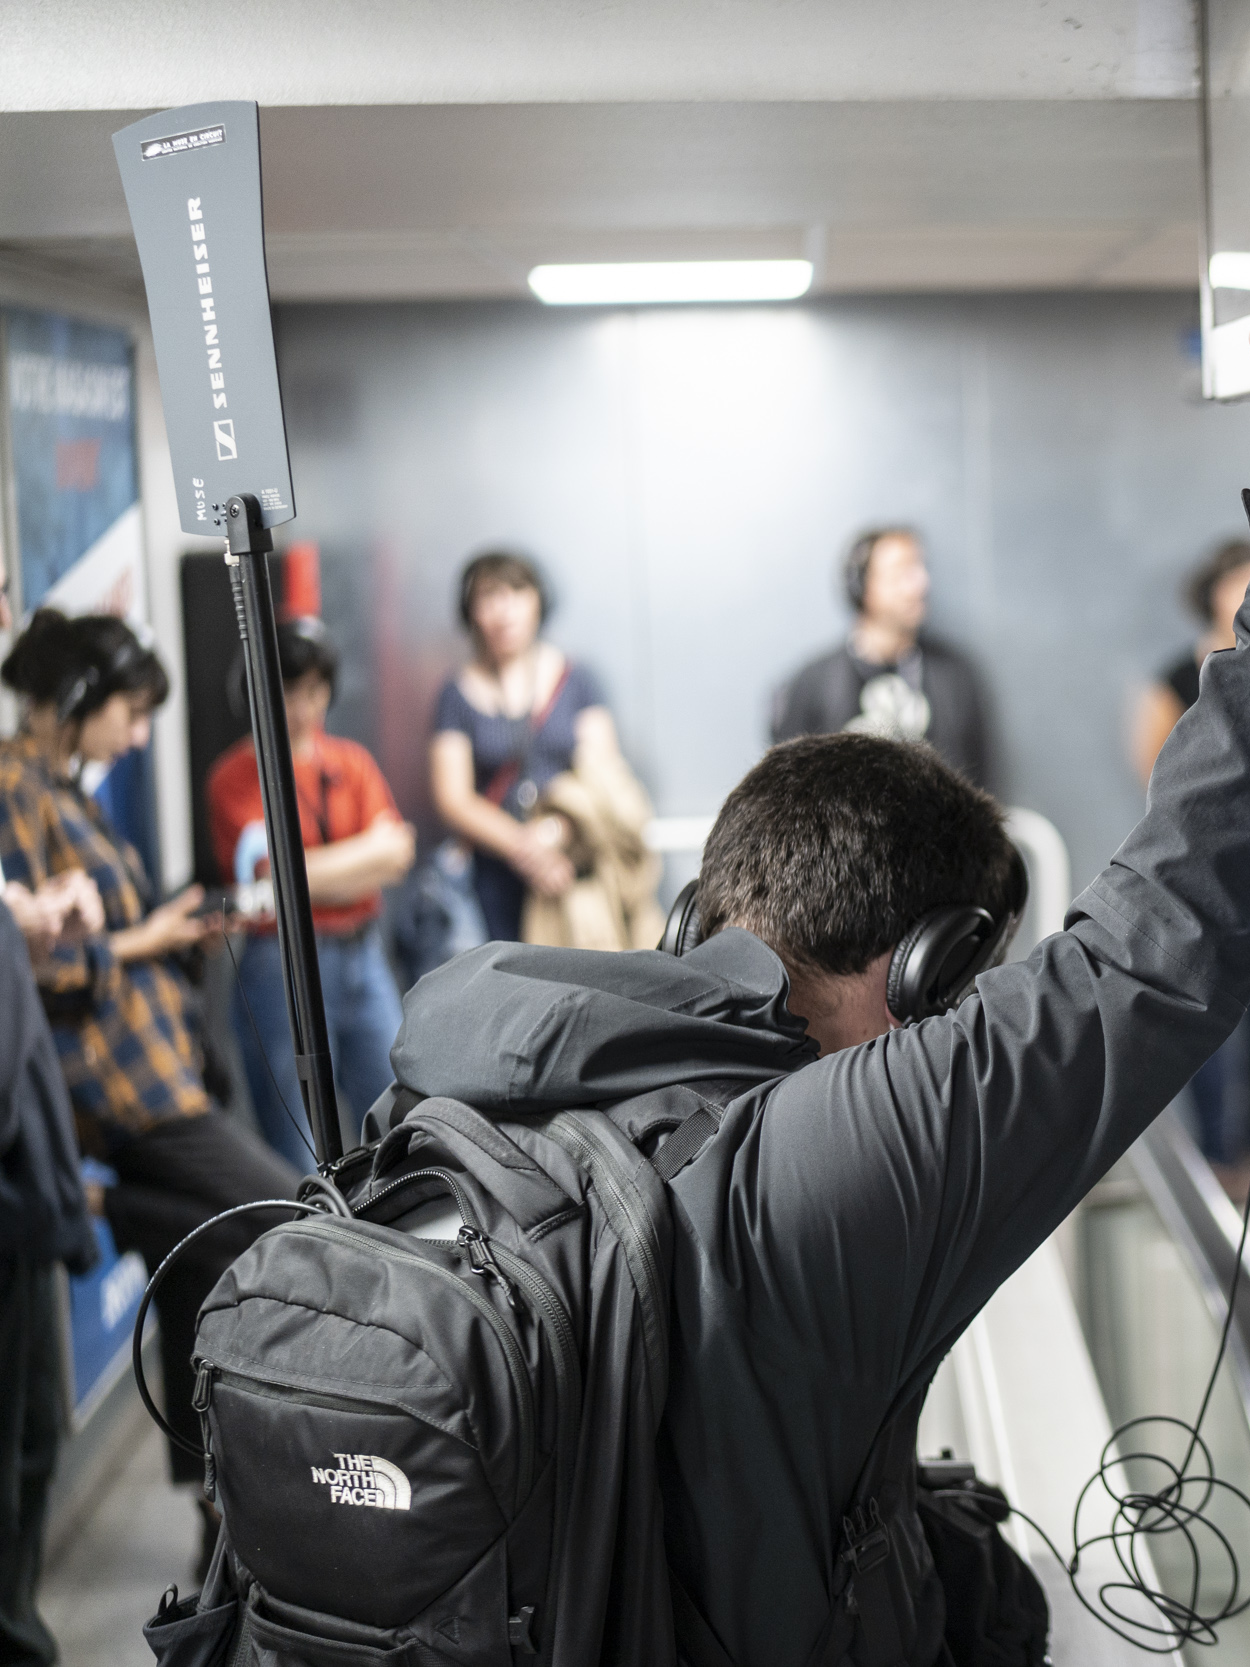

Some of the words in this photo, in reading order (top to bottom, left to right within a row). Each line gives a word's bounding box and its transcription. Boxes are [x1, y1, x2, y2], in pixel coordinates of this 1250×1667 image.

[187, 196, 228, 410] SENNHEISER
[192, 477, 207, 521] MUSE
[333, 1453, 374, 1471] THE
[310, 1466, 376, 1489] NORTH
[330, 1485, 377, 1507] FACE
